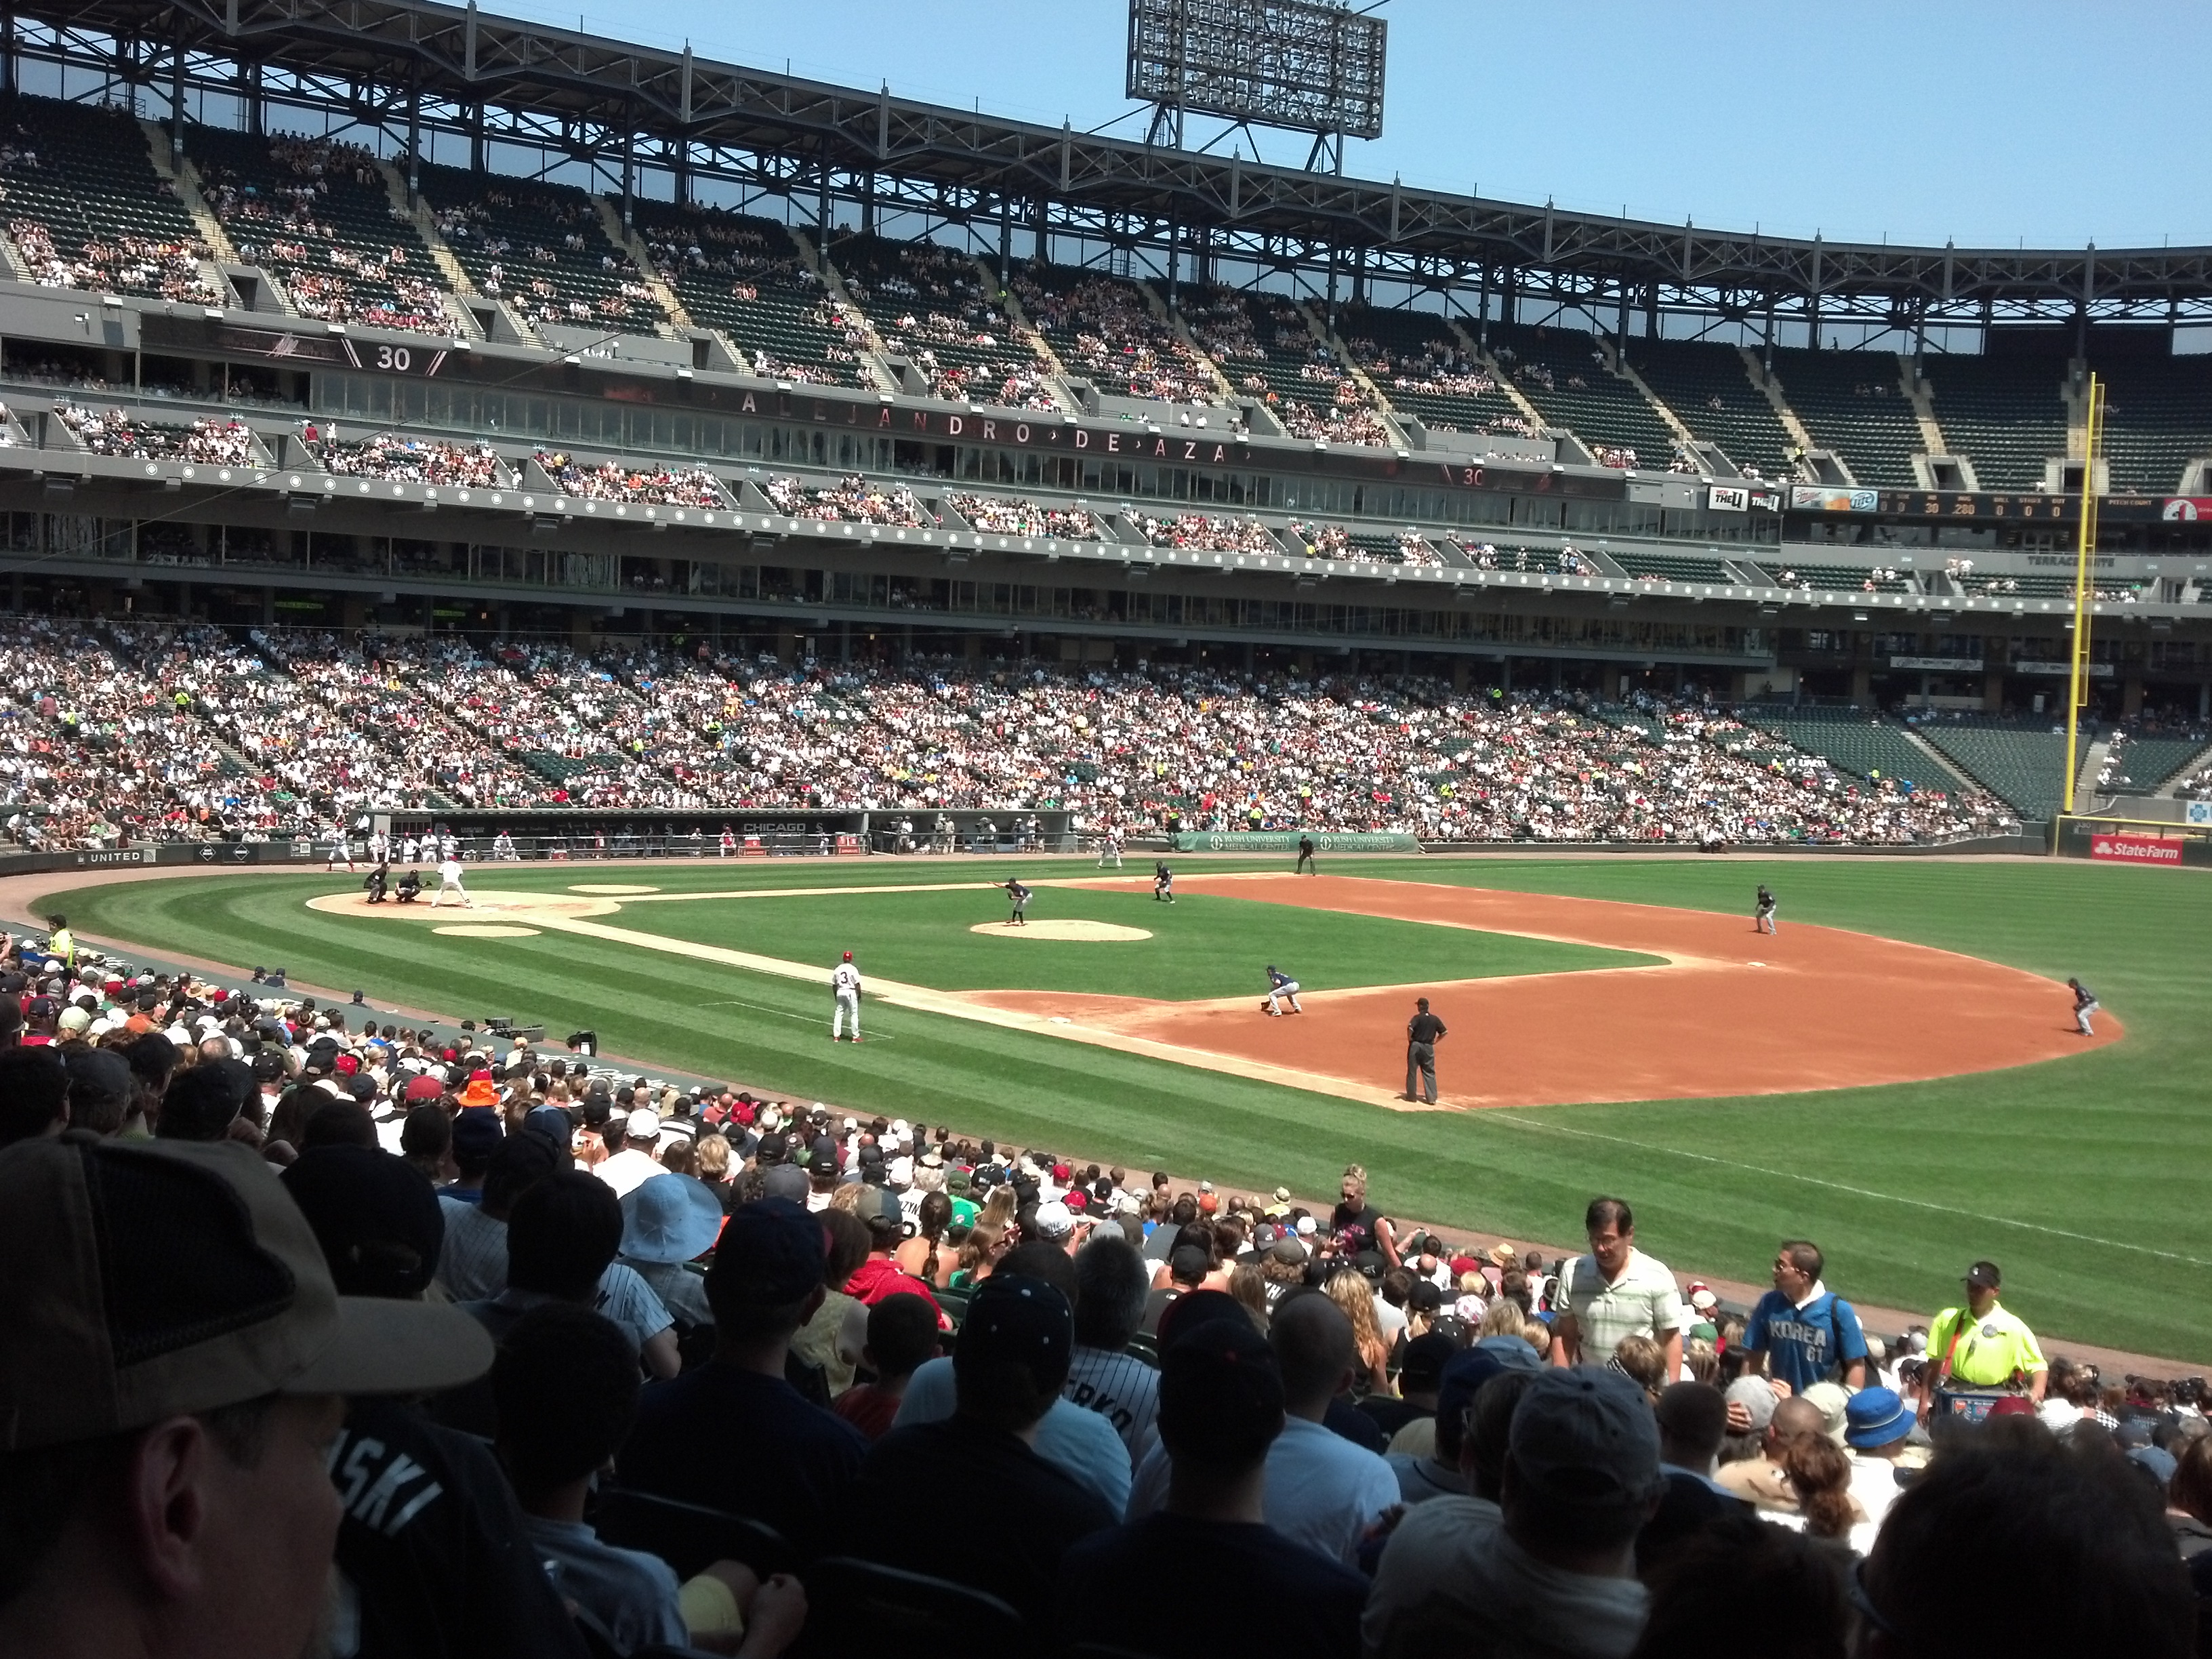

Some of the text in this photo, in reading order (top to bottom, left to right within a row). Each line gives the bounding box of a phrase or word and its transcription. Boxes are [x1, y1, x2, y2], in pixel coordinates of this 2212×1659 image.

[377, 346, 411, 371] 30
[1076, 430, 1120, 452] DE
[1155, 439, 1225, 463] AZA
[1715, 493, 1732, 504] THE
[1925, 503, 1939, 513] 30
[743, 823, 806, 832] CHICAGO
[1247, 835, 1290, 843] UNIVERSITY
[90, 852, 140, 862] UNITED
[840, 971, 848, 984] 3
[900, 1200, 920, 1216] ZYN
[1769, 1319, 1827, 1347] KOREA
[1806, 1345, 1824, 1363] 61
[1067, 1378, 1133, 1434] RKO
[327, 1429, 443, 1538] SKI
